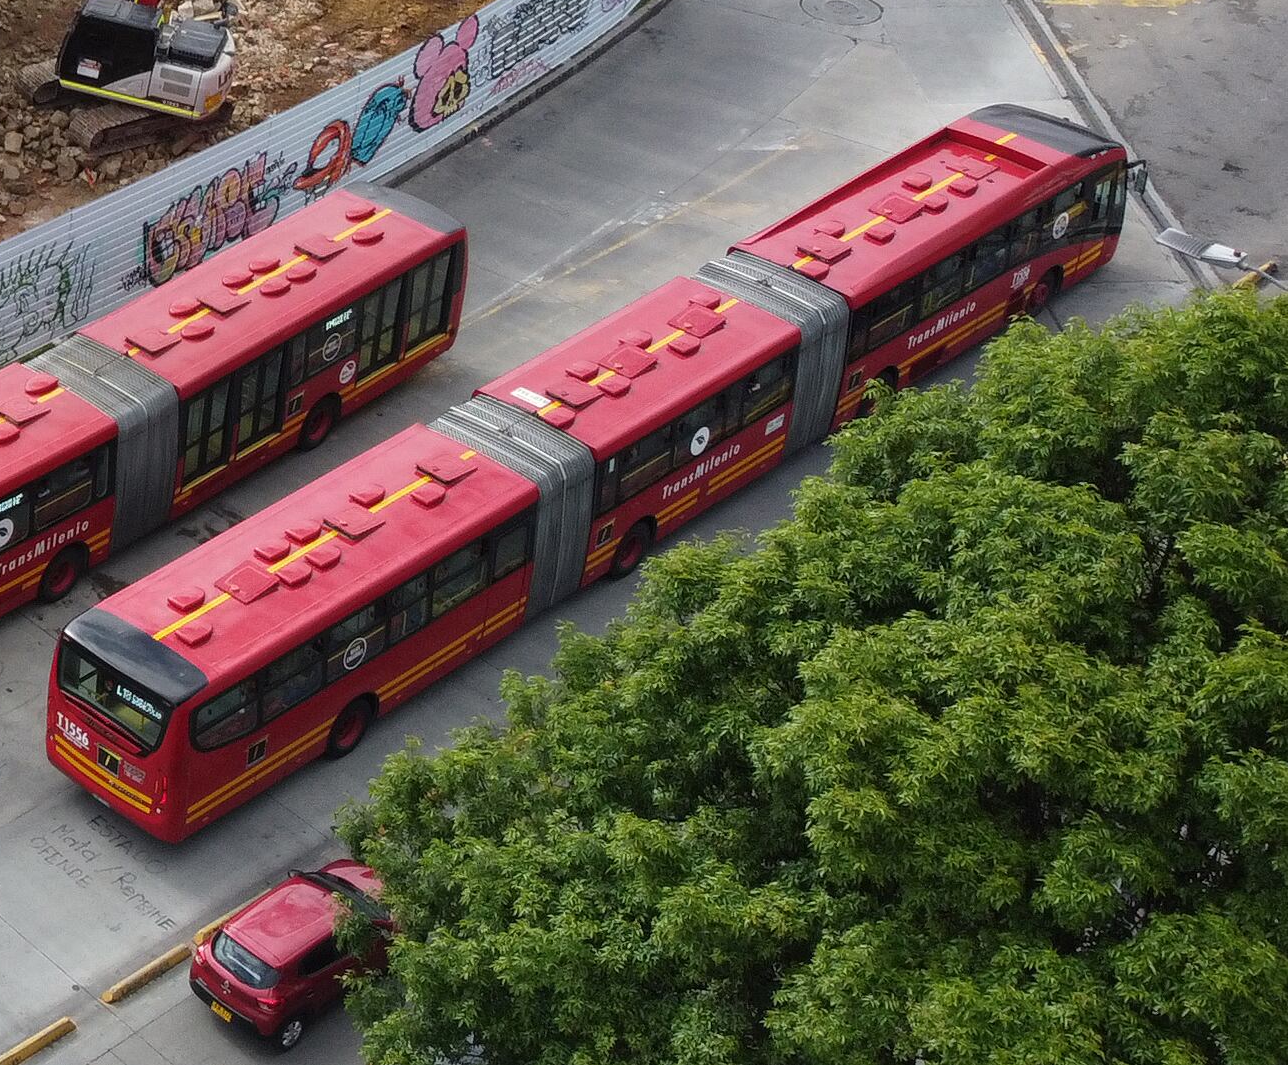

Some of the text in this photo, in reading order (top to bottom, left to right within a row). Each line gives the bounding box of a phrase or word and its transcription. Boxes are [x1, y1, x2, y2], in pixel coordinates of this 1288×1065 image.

[906, 301, 977, 350] TransMilenio
[662, 443, 741, 500] TransMilenio
[56, 710, 90, 747] T1556
